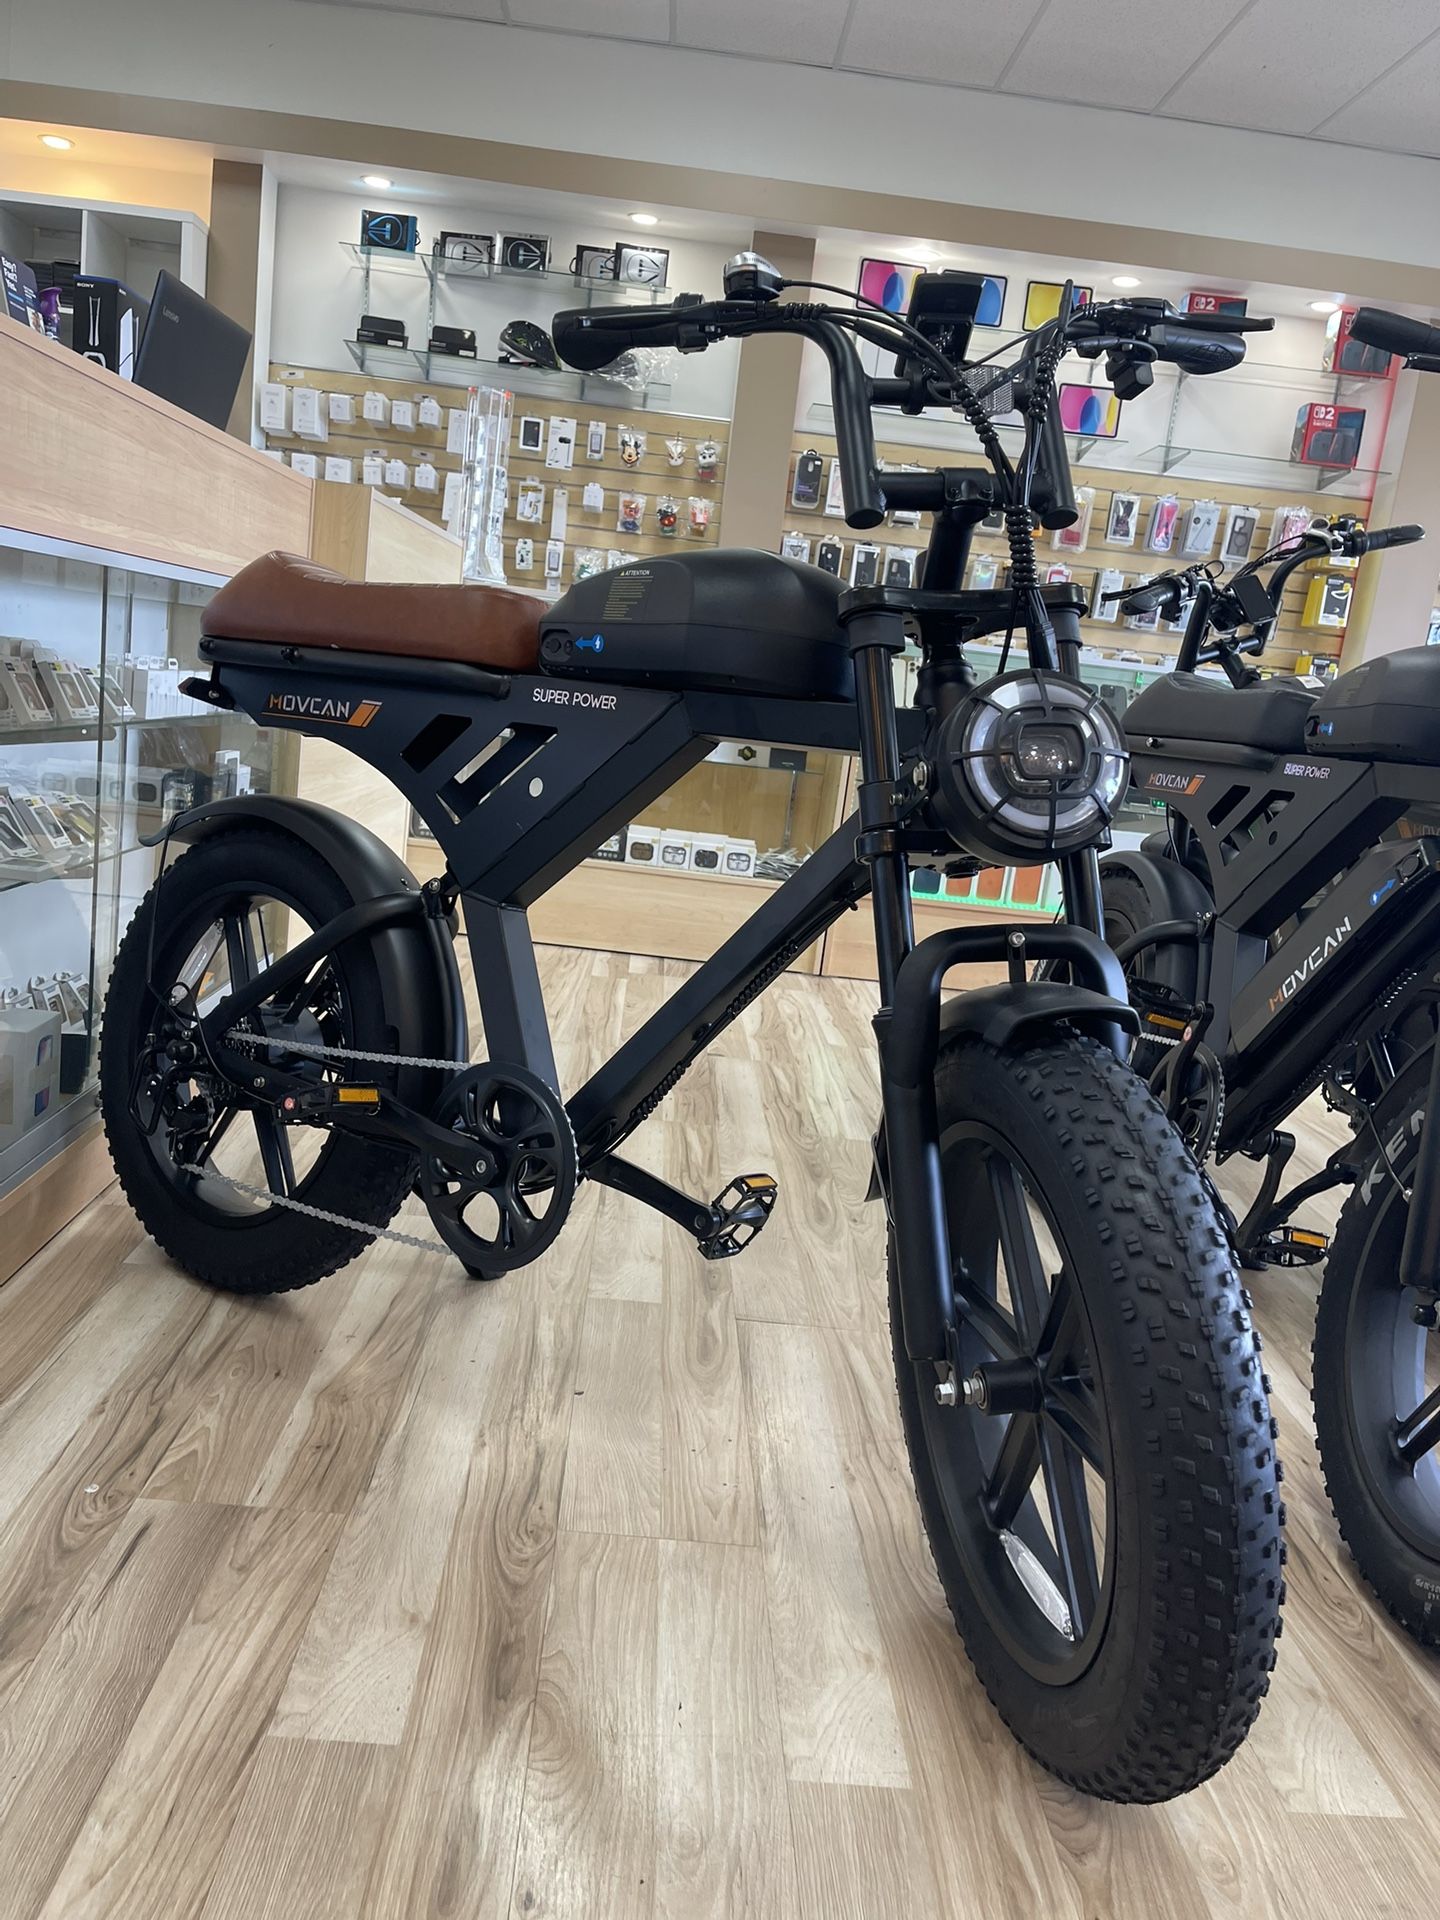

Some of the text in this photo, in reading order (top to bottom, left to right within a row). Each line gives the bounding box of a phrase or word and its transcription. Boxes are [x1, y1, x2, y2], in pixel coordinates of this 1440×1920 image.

[1325, 406, 1335, 420] 2
[625, 569, 650, 577] ATTENTION
[269, 693, 350, 719] MOVCAN
[532, 687, 617, 711] SUPER POWER
[1283, 762, 1331, 779] SUPER POWER
[1149, 772, 1190, 789] MOVCAN
[1268, 915, 1352, 1013] MOVCAN
